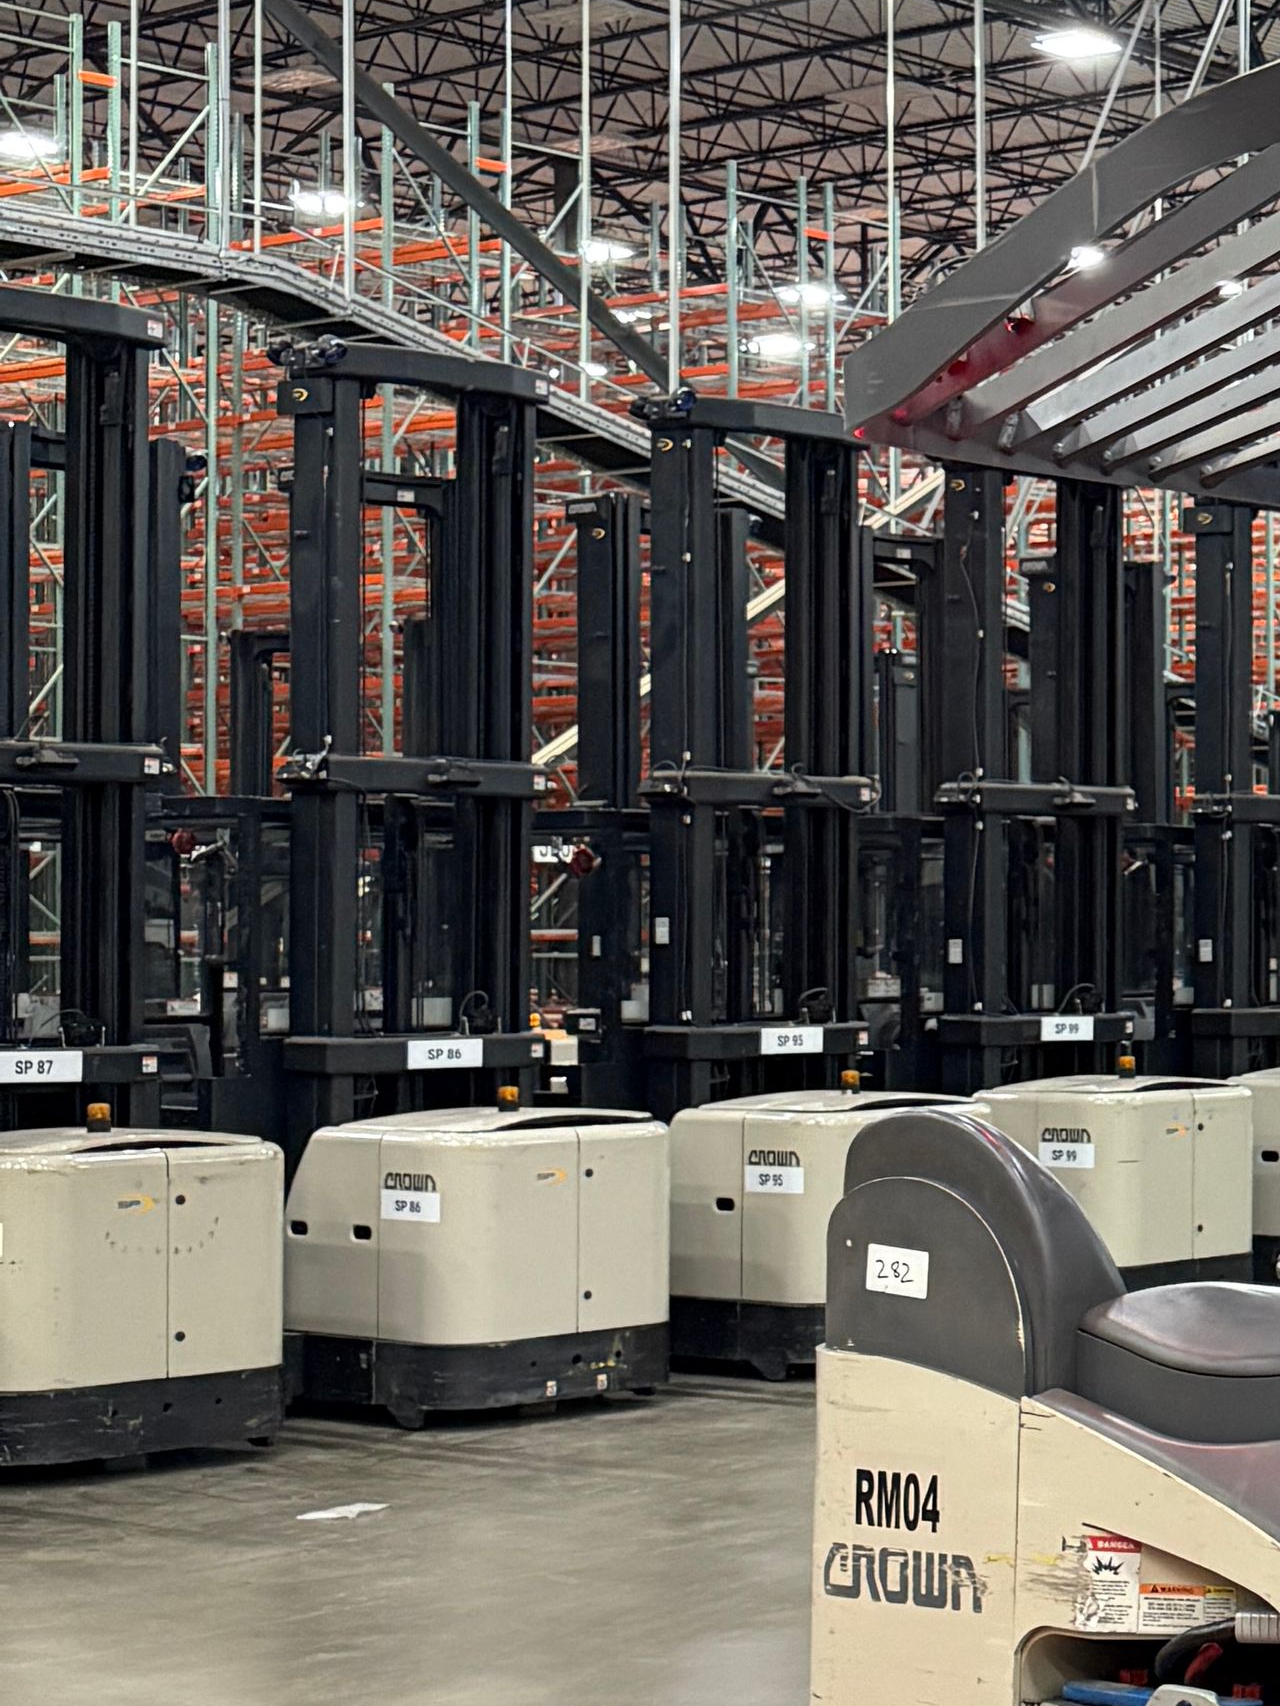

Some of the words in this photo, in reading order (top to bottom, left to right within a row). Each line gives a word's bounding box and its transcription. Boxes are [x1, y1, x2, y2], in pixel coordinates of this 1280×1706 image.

[1055, 1023, 1067, 1034] SP
[777, 1035, 790, 1047] SP
[428, 1049, 444, 1060] SP
[447, 1048, 462, 1060] 86
[15, 1060, 33, 1075] SP
[37, 1060, 54, 1075] 87
[1041, 1127, 1092, 1143] CROWN
[748, 1150, 801, 1167] CROWN
[1052, 1150, 1063, 1161] SP
[384, 1172, 437, 1192] CROWN
[758, 1173, 771, 1186] SP
[395, 1200, 408, 1211] SP
[409, 1201, 422, 1214] 86
[875, 1259, 915, 1283] 282
[855, 1468, 941, 1534] RM04
[823, 1542, 983, 1614] CROWN
